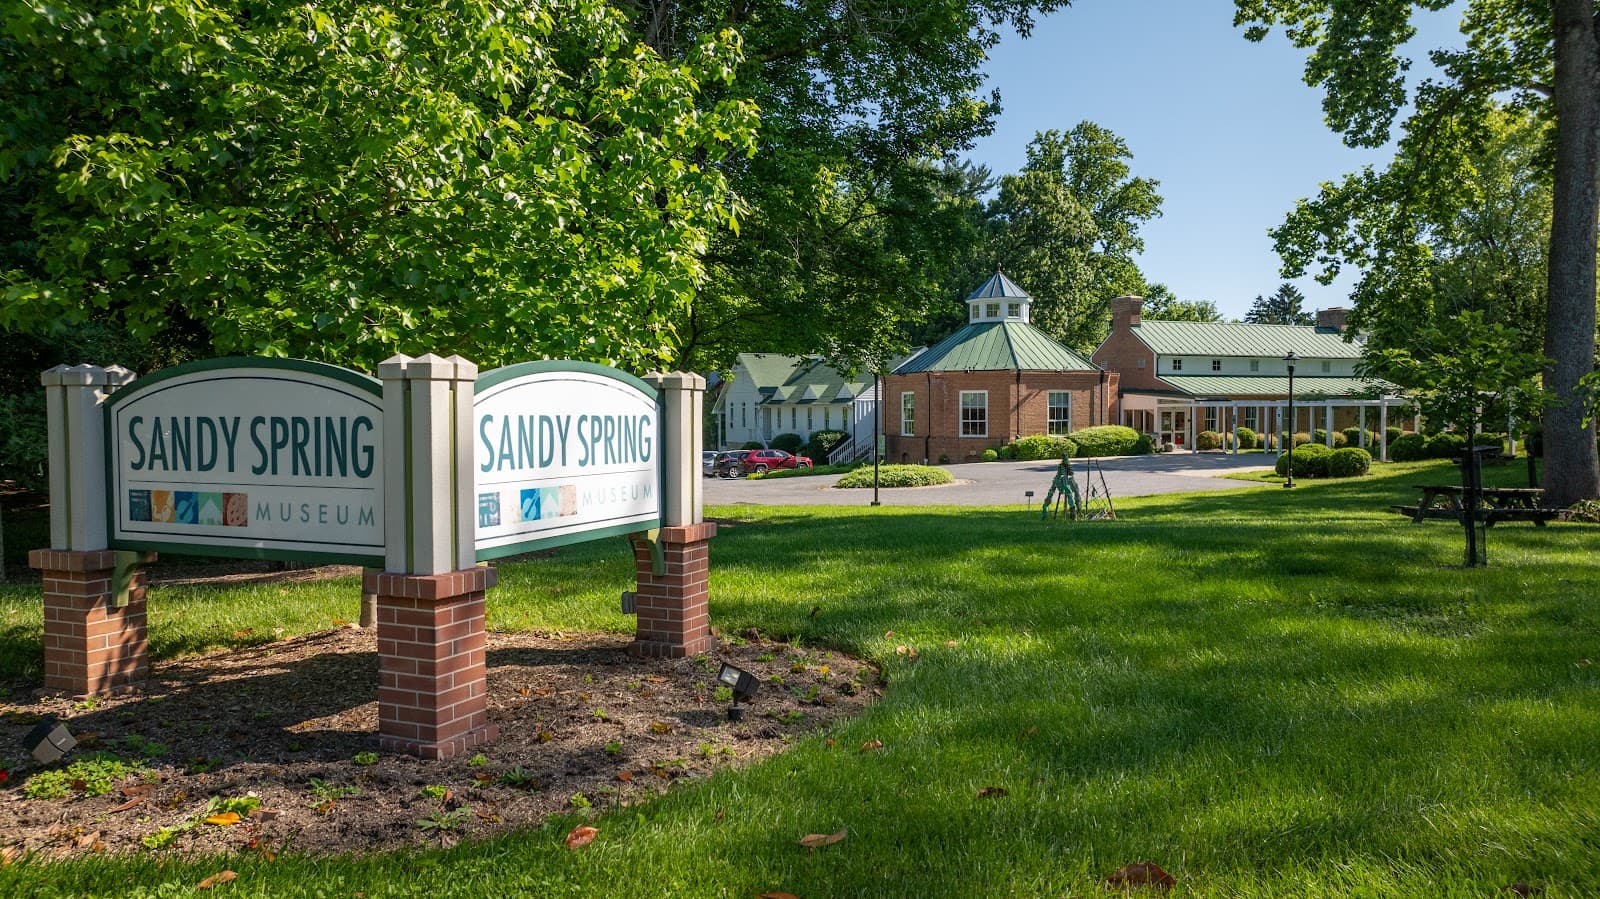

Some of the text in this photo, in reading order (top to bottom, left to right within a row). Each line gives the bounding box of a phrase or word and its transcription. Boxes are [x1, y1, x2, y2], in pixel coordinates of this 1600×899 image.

[128, 415, 375, 478] SANDY SPRING
[479, 414, 652, 473] SANDY SPRING
[256, 503, 375, 527] MUSEUM
[582, 484, 652, 507] MUSEUM
